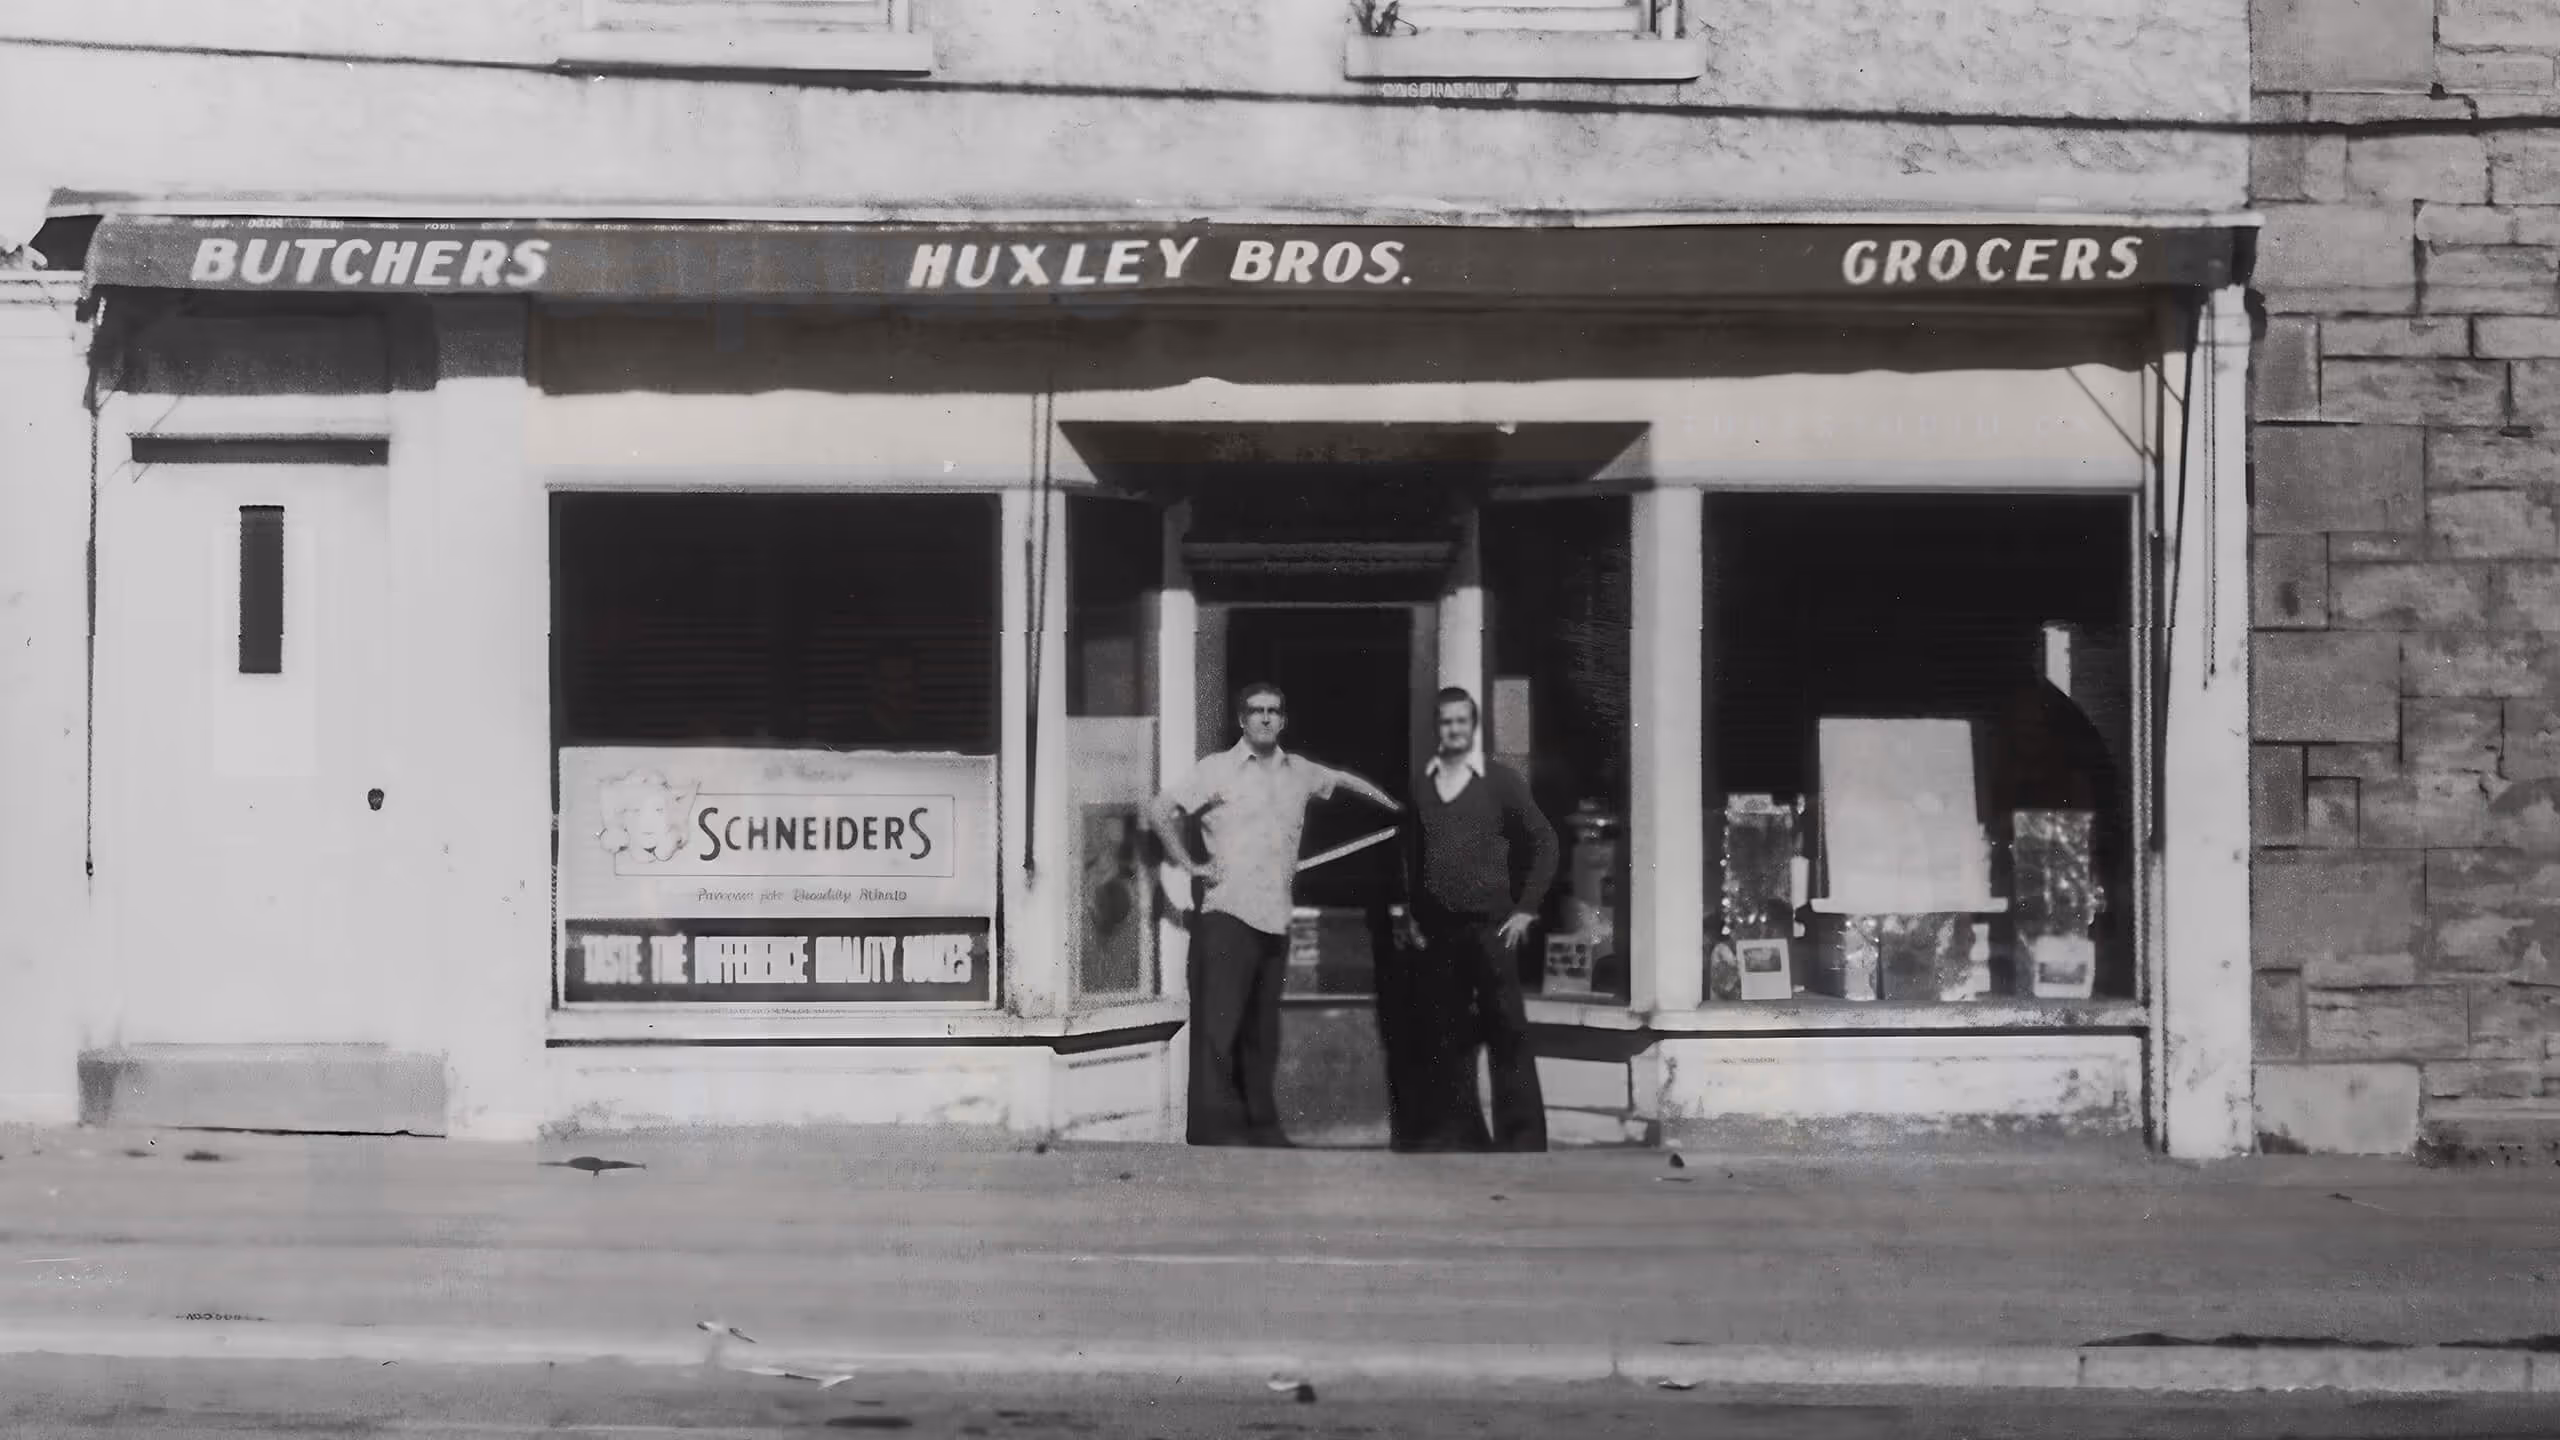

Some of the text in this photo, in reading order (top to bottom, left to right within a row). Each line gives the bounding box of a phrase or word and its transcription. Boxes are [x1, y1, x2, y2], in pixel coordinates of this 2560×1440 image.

[190, 238, 550, 286] BUTCHERS
[906, 237, 1411, 288] HUXLEY BROS.
[1843, 237, 2142, 284] GROCERS
[699, 807, 931, 861] SCHNEIDERS
